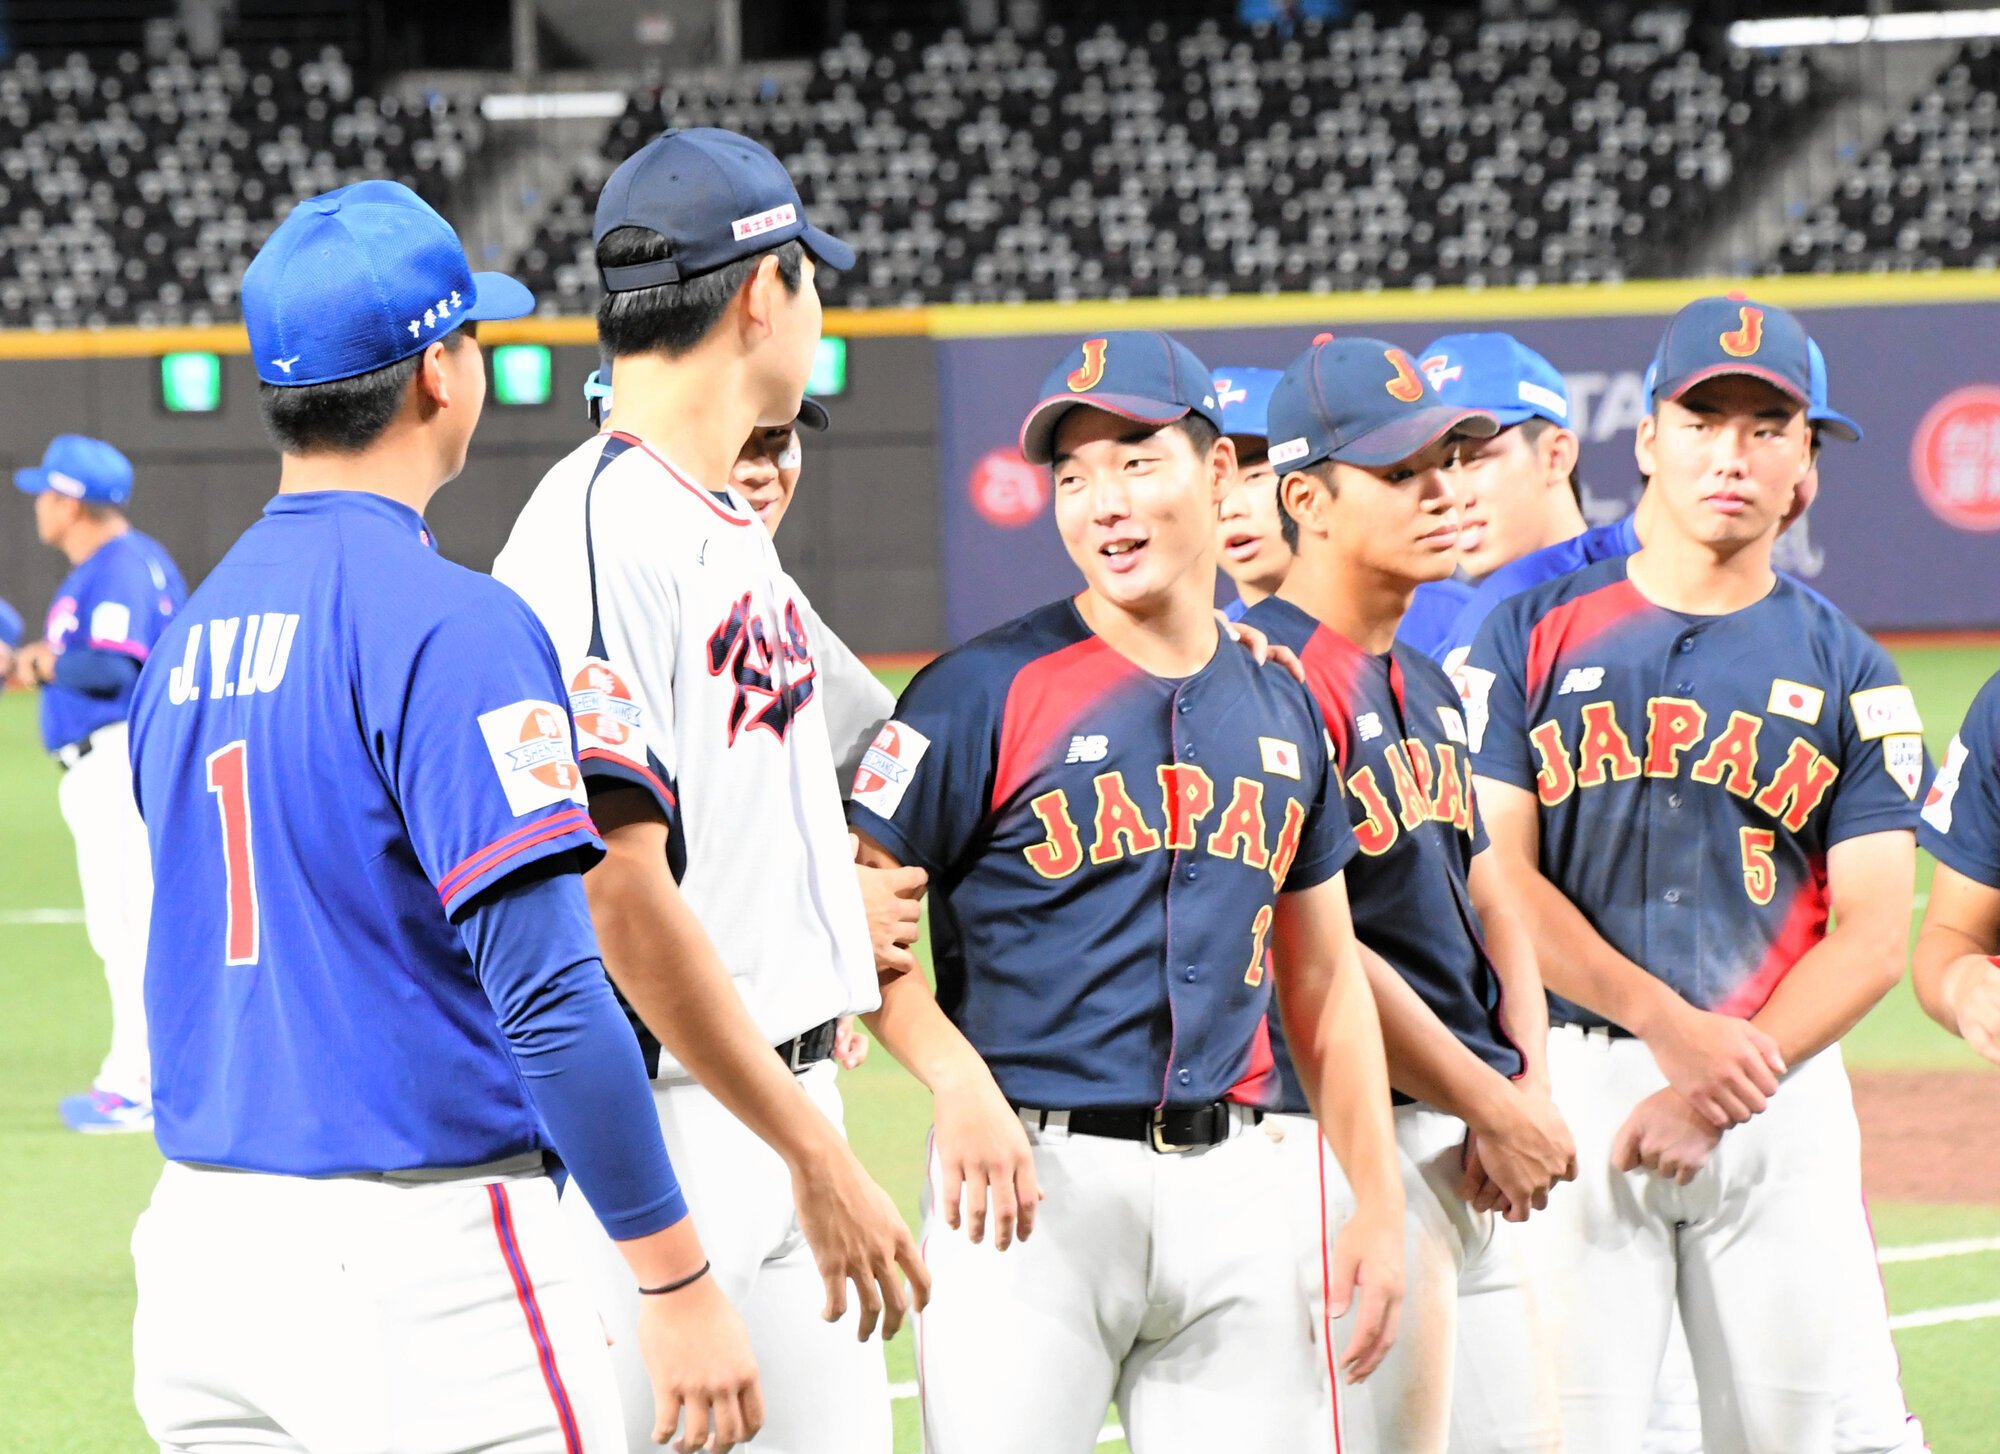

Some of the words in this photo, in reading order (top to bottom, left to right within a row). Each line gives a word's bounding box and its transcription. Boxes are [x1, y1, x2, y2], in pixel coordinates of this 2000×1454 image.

[1067, 338, 1108, 393] J
[1719, 306, 1764, 357] J
[1384, 349, 1424, 402] J
[1529, 695, 1840, 834] JAPAN
[206, 739, 259, 966] 1
[1738, 826, 1778, 906] 5
[1244, 904, 1273, 987] 2
